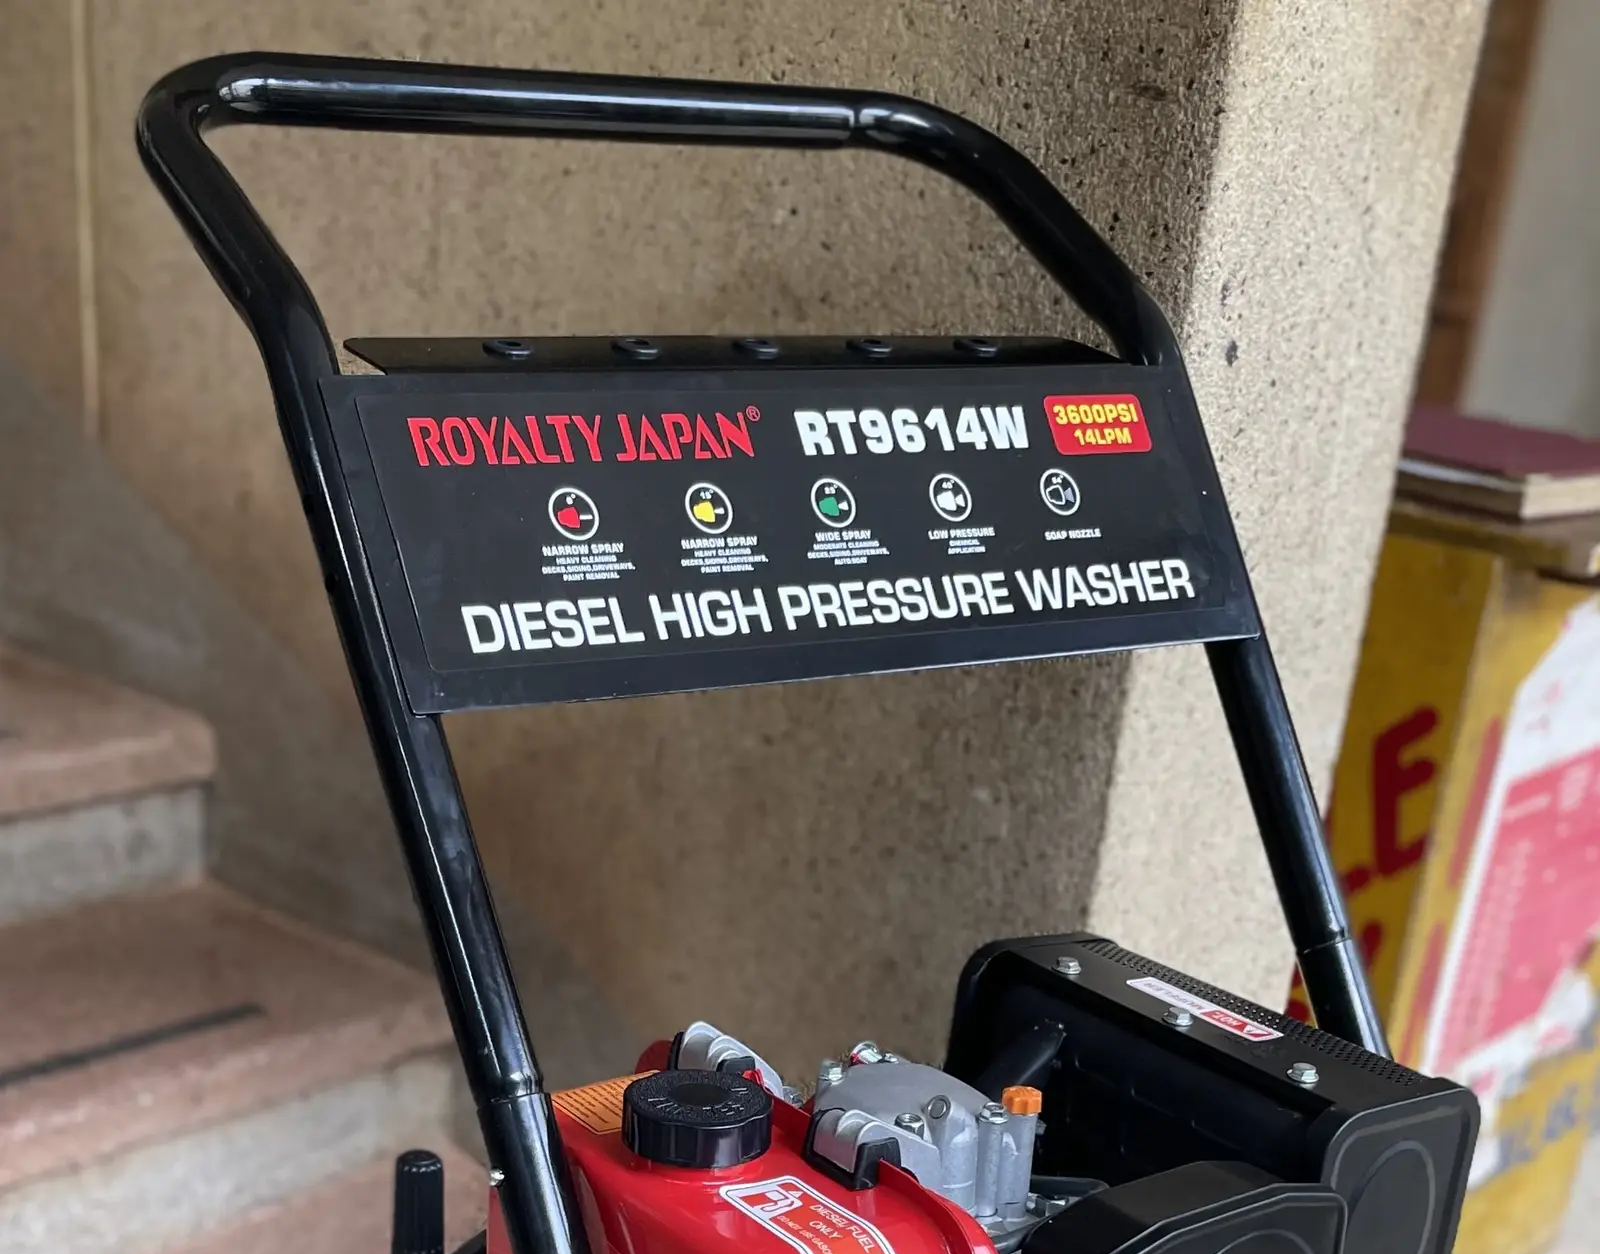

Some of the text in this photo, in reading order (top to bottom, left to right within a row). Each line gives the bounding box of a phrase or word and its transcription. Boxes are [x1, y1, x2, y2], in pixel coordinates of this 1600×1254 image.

[1053, 403, 1139, 425] 3600PSI
[407, 414, 601, 466] ROYALTY
[793, 406, 1028, 456] RT9614W
[1074, 428, 1132, 446] 14LPM
[681, 536, 757, 549] NARROW SPRAY
[815, 530, 871, 541] WIDE SPRAY
[928, 527, 995, 540] LOW PRESSURE
[1045, 528, 1101, 540] SOAP NOZZLE
[542, 543, 624, 556] NARROW SPRAY
[461, 558, 1195, 655] DIESEL HIGH PRESSURE WASHER
[809, 1204, 876, 1254] DIESEL FUEL
[809, 1220, 843, 1240] ONLY
